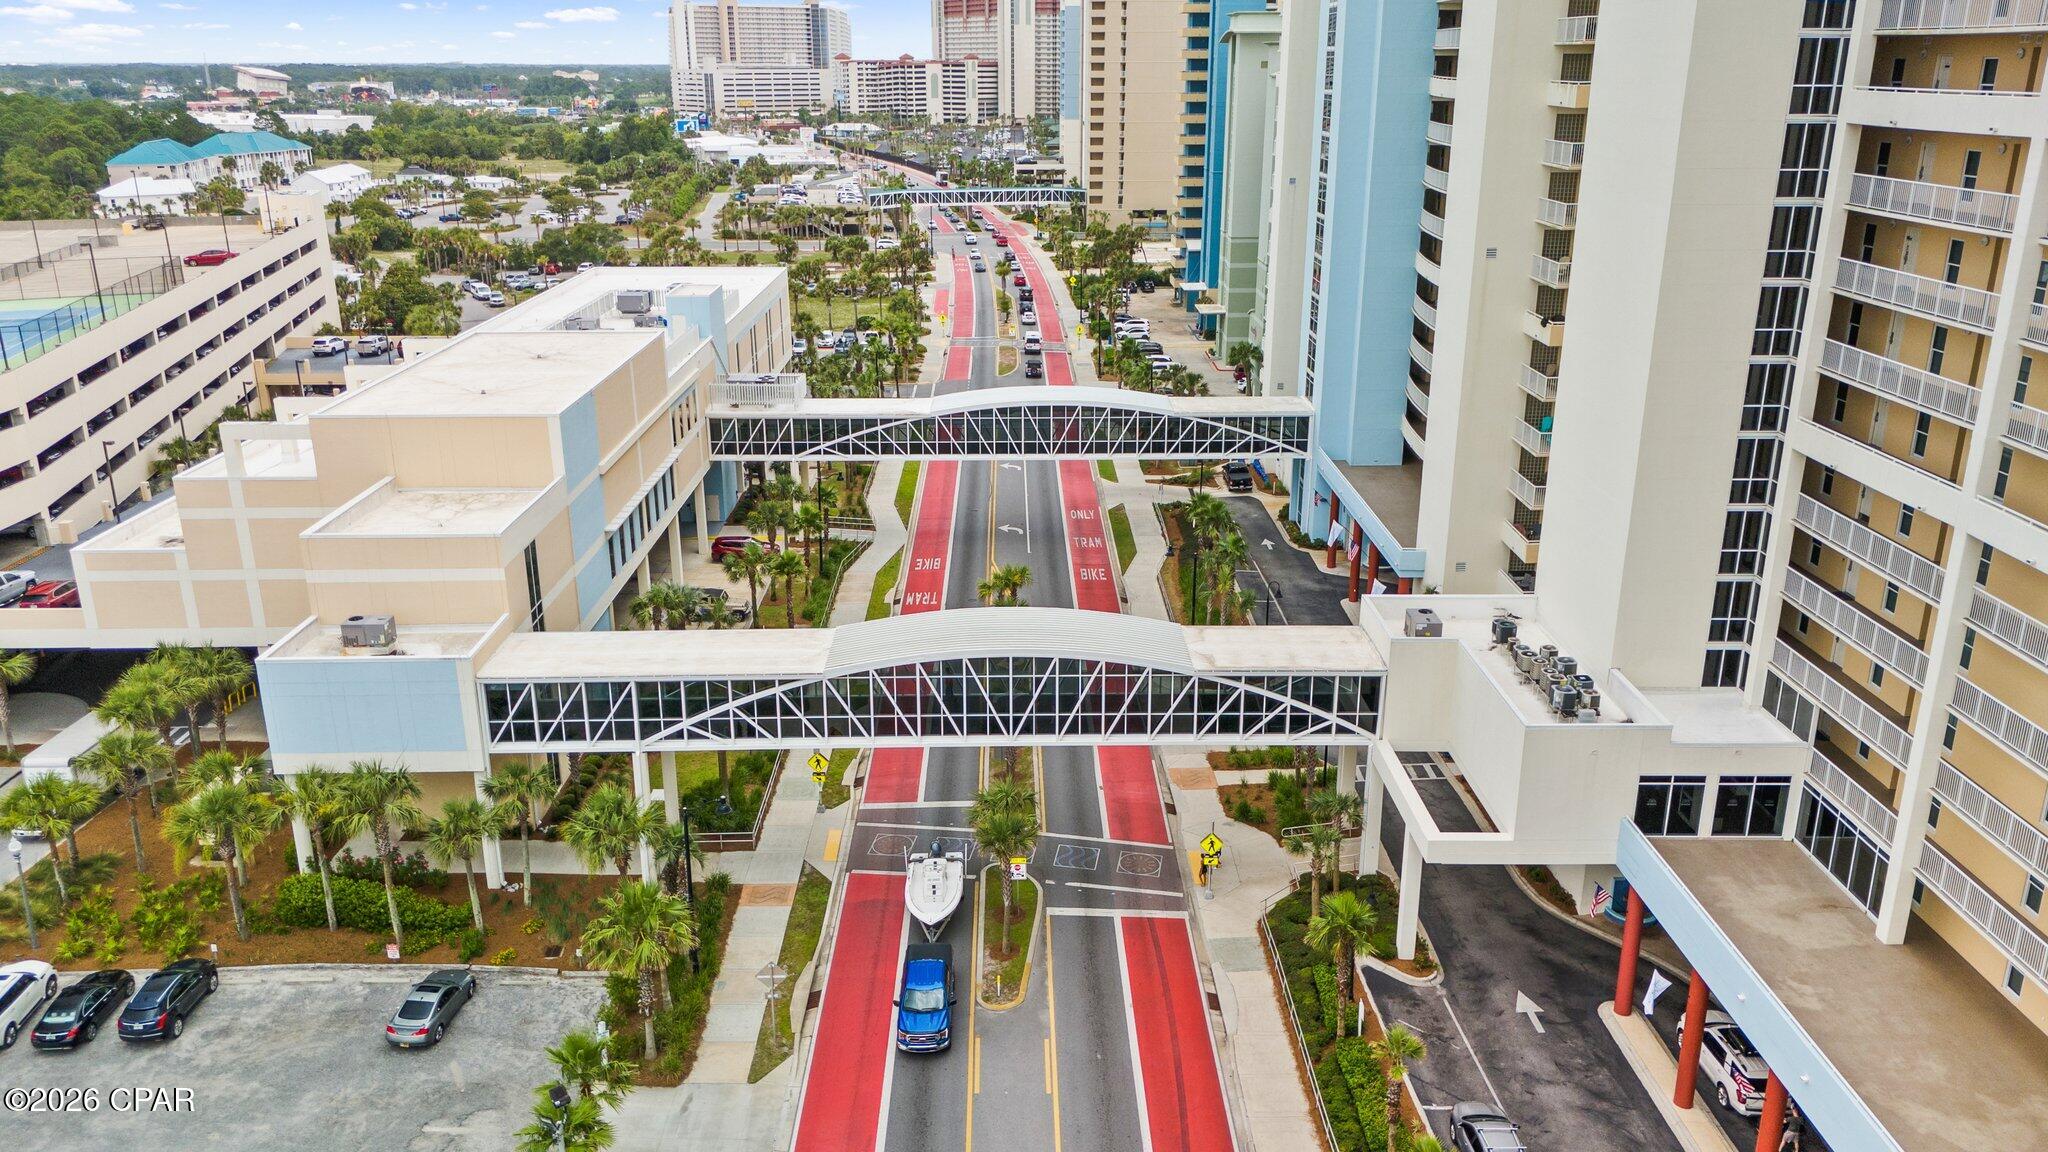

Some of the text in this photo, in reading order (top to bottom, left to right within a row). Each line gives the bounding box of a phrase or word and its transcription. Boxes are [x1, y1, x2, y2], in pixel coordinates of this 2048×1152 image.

[1070, 509, 1095, 519] ONLY
[1073, 536, 1103, 548] TRAM
[915, 557, 942, 570] BIKE
[1080, 568, 1107, 580] BIKE
[905, 592, 938, 605] TRAM
